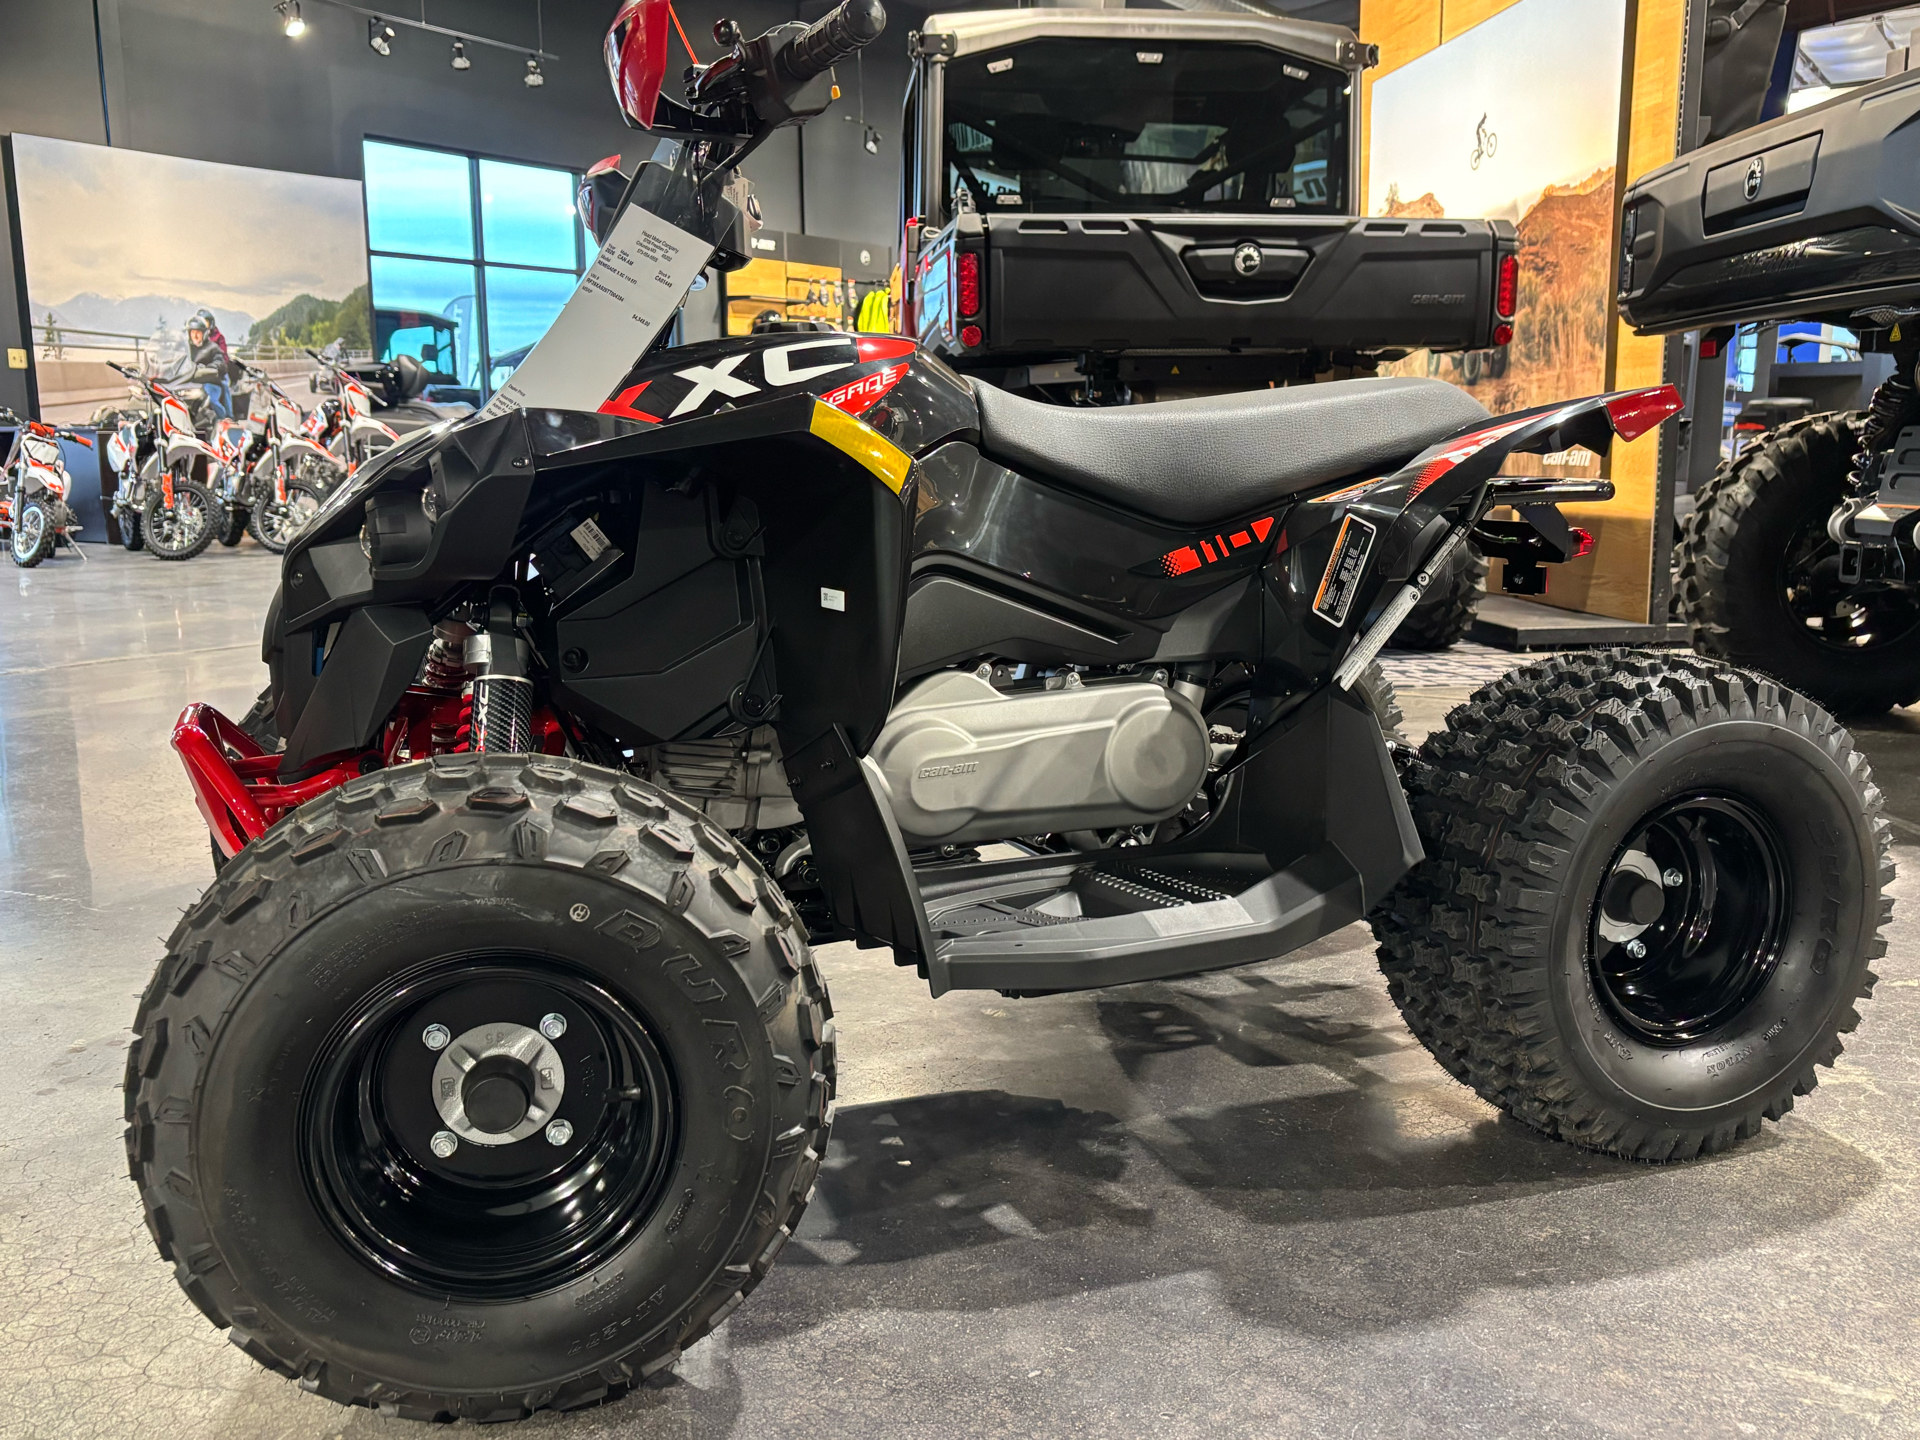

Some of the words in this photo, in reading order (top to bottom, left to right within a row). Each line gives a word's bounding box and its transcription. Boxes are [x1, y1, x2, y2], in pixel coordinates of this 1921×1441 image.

[620, 249, 629, 257] Make
[662, 241, 679, 254] Company
[617, 254, 626, 262] CAN
[598, 260, 617, 274] RENEGADE
[1542, 450, 1591, 466] can-am
[918, 761, 979, 779] can-am
[322, 931, 364, 964] VEHICLE
[312, 967, 334, 988] FOR
